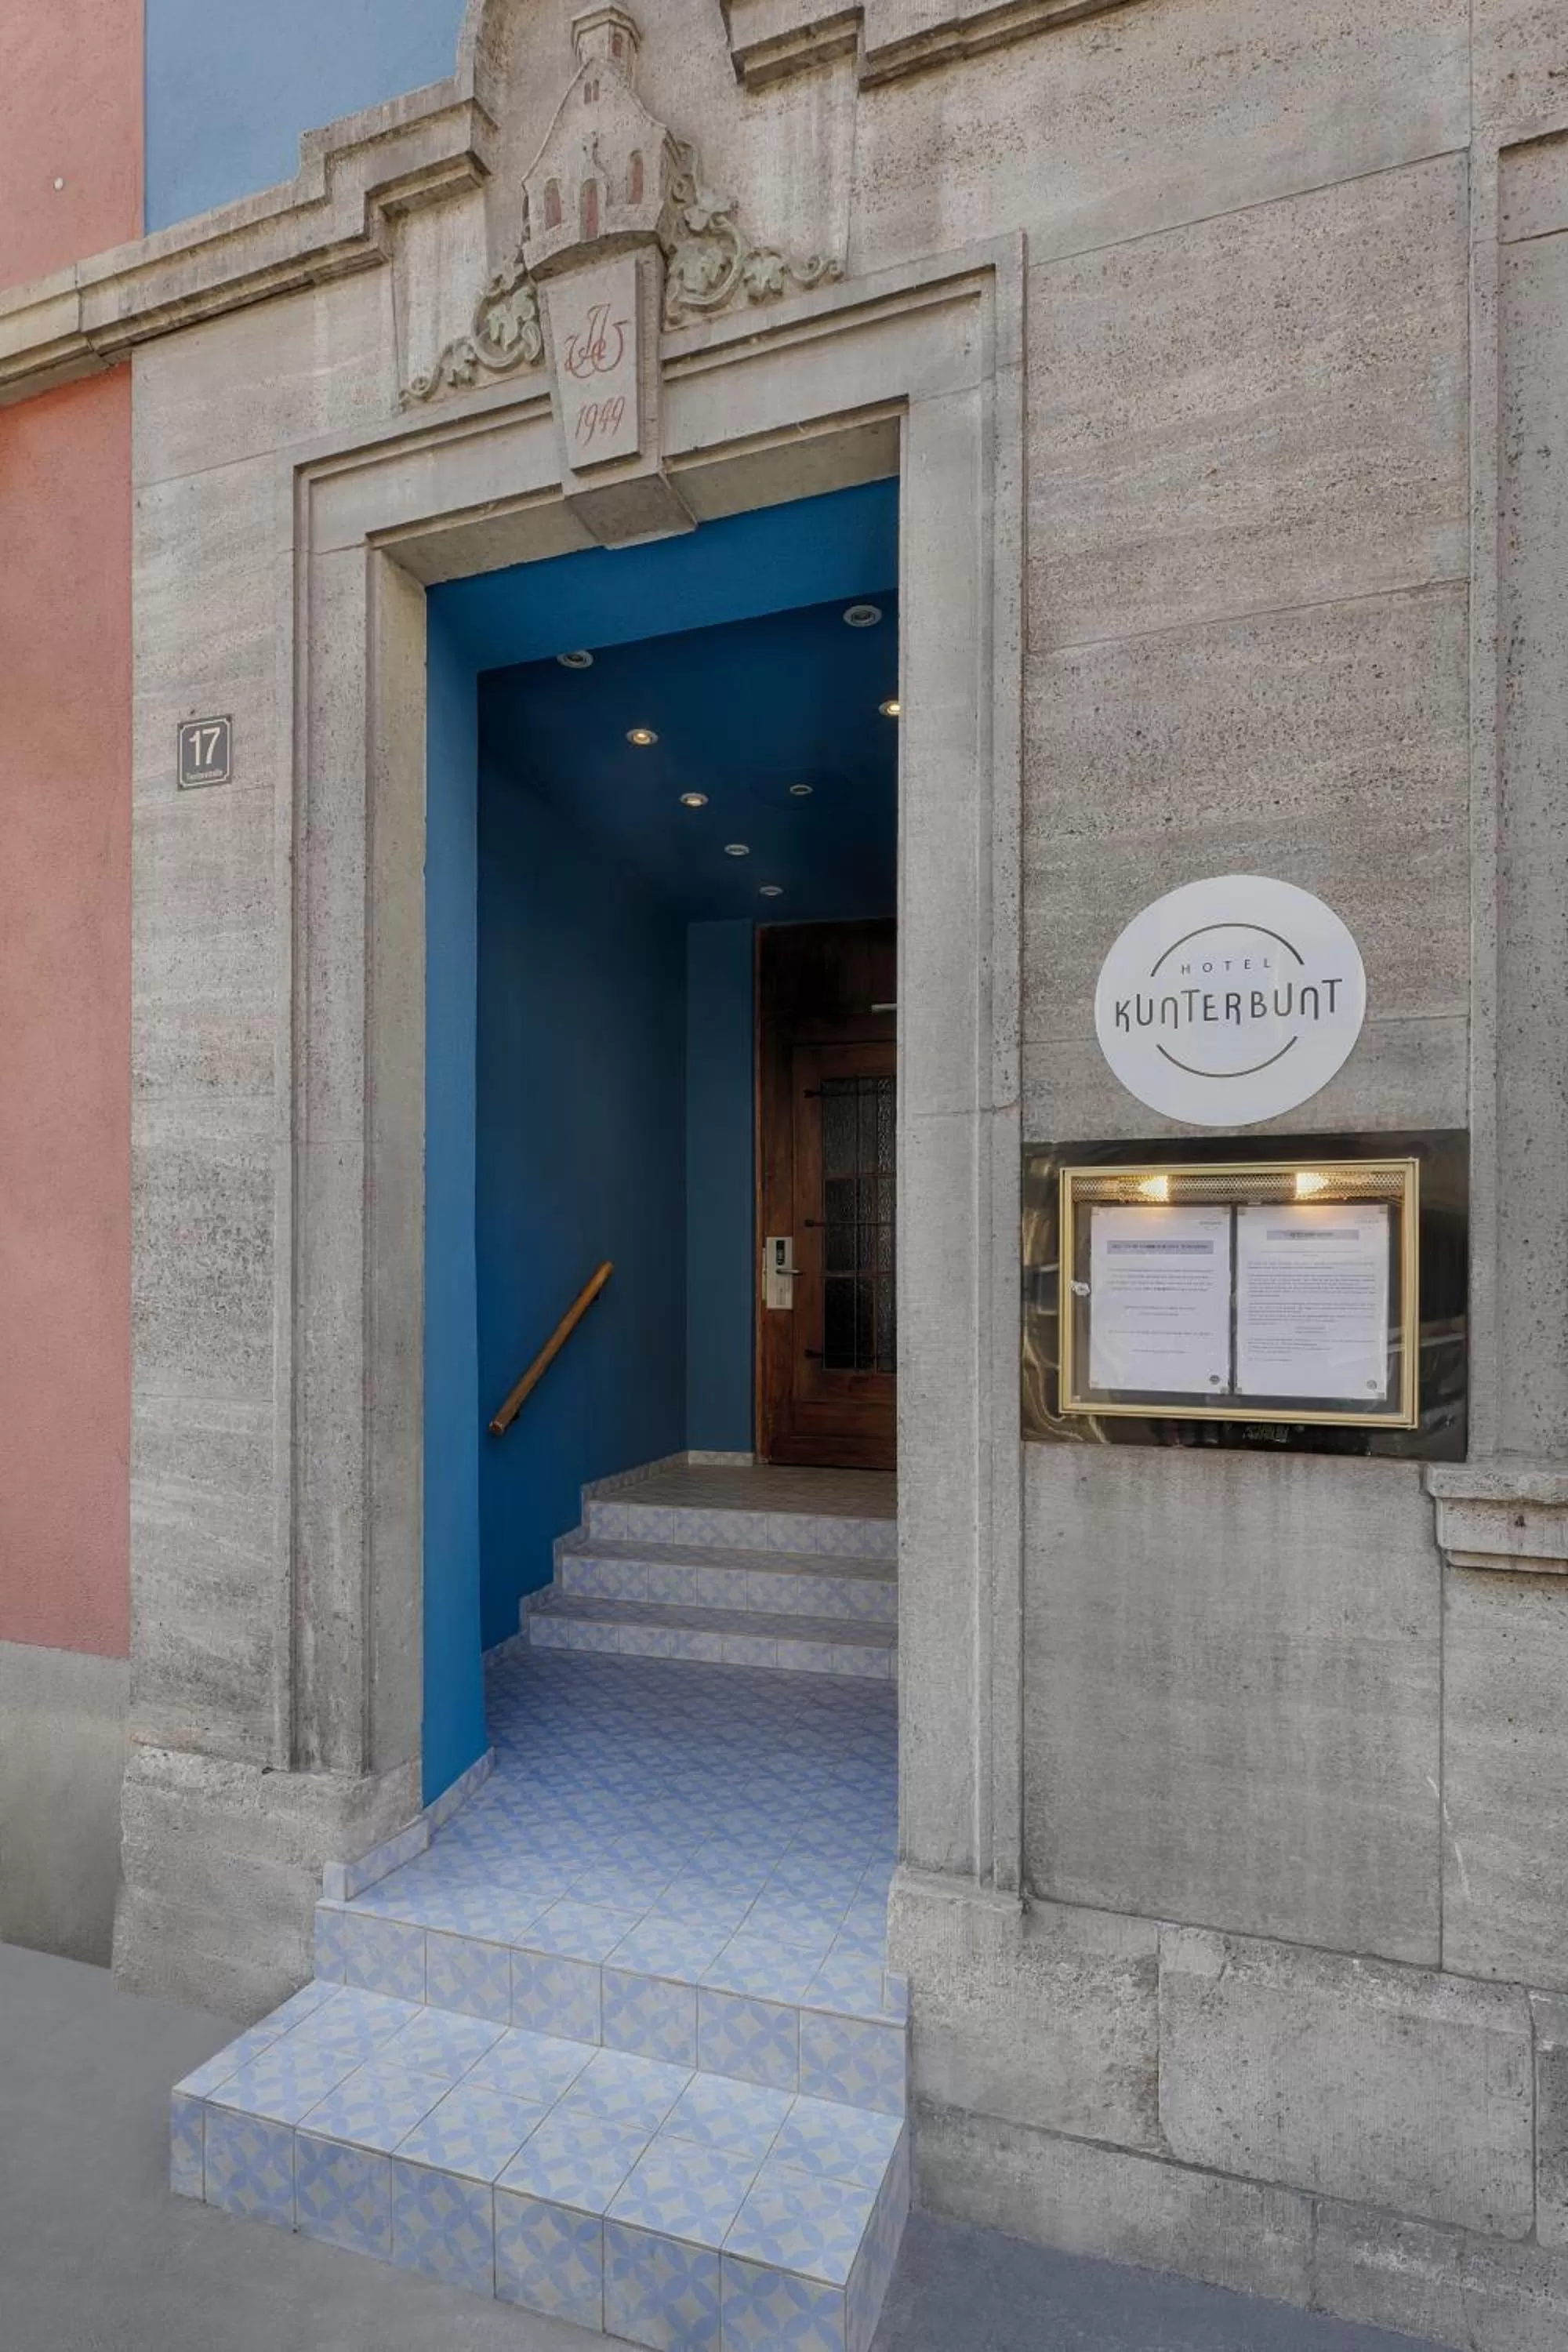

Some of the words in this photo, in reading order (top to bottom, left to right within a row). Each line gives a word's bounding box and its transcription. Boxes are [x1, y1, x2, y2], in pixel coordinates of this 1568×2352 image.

[188, 727, 220, 766] 17
[1181, 957, 1273, 975] HOTEL
[1115, 978, 1343, 1033] KUNTERBUNT
